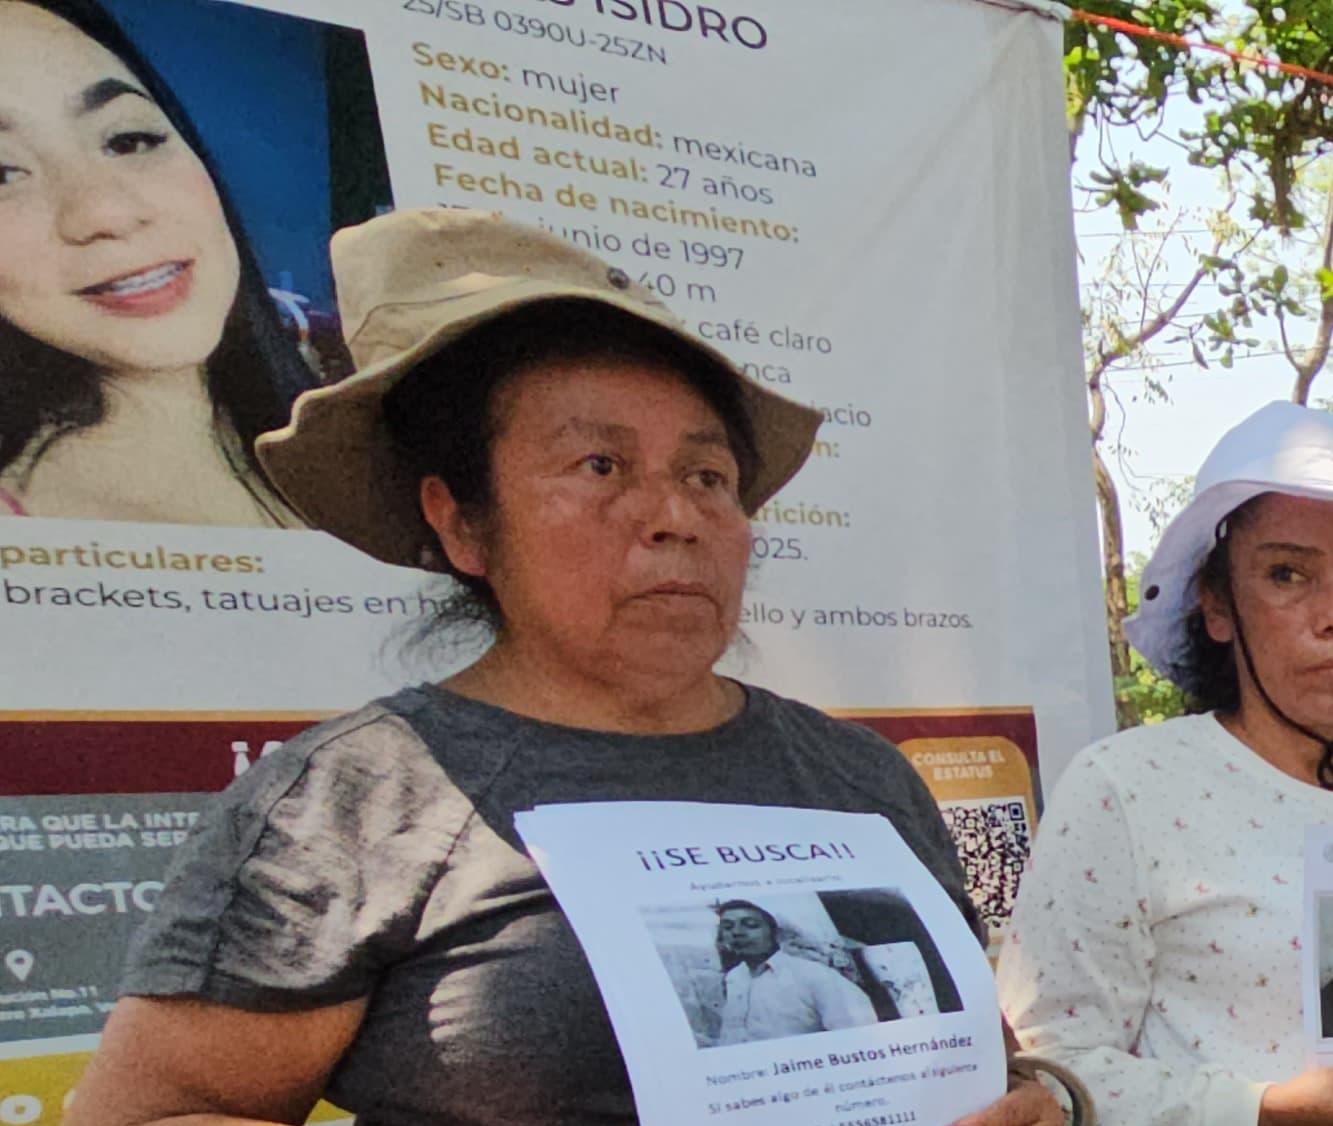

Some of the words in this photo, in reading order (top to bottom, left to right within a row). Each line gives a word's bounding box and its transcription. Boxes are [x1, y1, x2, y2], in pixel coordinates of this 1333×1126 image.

[411, 41, 510, 82] Sexo:
[522, 67, 619, 103] mujer
[418, 81, 664, 150] Nacionalidad:
[673, 135, 818, 179] mexicana
[426, 122, 521, 161] Edad
[533, 143, 649, 184] actual:
[656, 163, 691, 191] 27
[702, 175, 774, 206] años
[433, 163, 543, 203] Fecha
[555, 183, 598, 212] de
[608, 195, 800, 244] nacimiento:
[631, 232, 671, 260] de
[681, 239, 746, 271] 1997
[687, 281, 717, 303] m
[698, 318, 761, 345] café
[769, 327, 833, 355] claro
[739, 361, 792, 385] nca
[752, 500, 851, 529] rición:
[0, 542, 266, 575] particulares:
[751, 536, 809, 562] 025.
[2, 579, 192, 613] brackets,
[202, 587, 354, 620] tatuajes
[363, 595, 408, 616] en
[739, 603, 785, 625] ello
[789, 609, 807, 630] y
[813, 606, 898, 628] ambos
[903, 607, 975, 629] brazos.
[912, 750, 987, 766] CONSULTA
[988, 749, 1006, 764] EL
[933, 765, 993, 781] ESTATUS
[0, 815, 38, 831] RA
[41, 813, 99, 832] QUE
[103, 812, 140, 830] LA
[49, 832, 135, 850] PUEDA
[714, 842, 857, 865] BUSCA!!
[0, 879, 168, 918] TACTO
[705, 1068, 769, 1088] Nombre:
[772, 1056, 825, 1077] Jaime
[827, 1048, 887, 1068] Bustos
[888, 1034, 973, 1058] Hernández
[724, 1096, 766, 1113] sabes
[770, 1090, 800, 1106] algo
[802, 1086, 819, 1099] de
